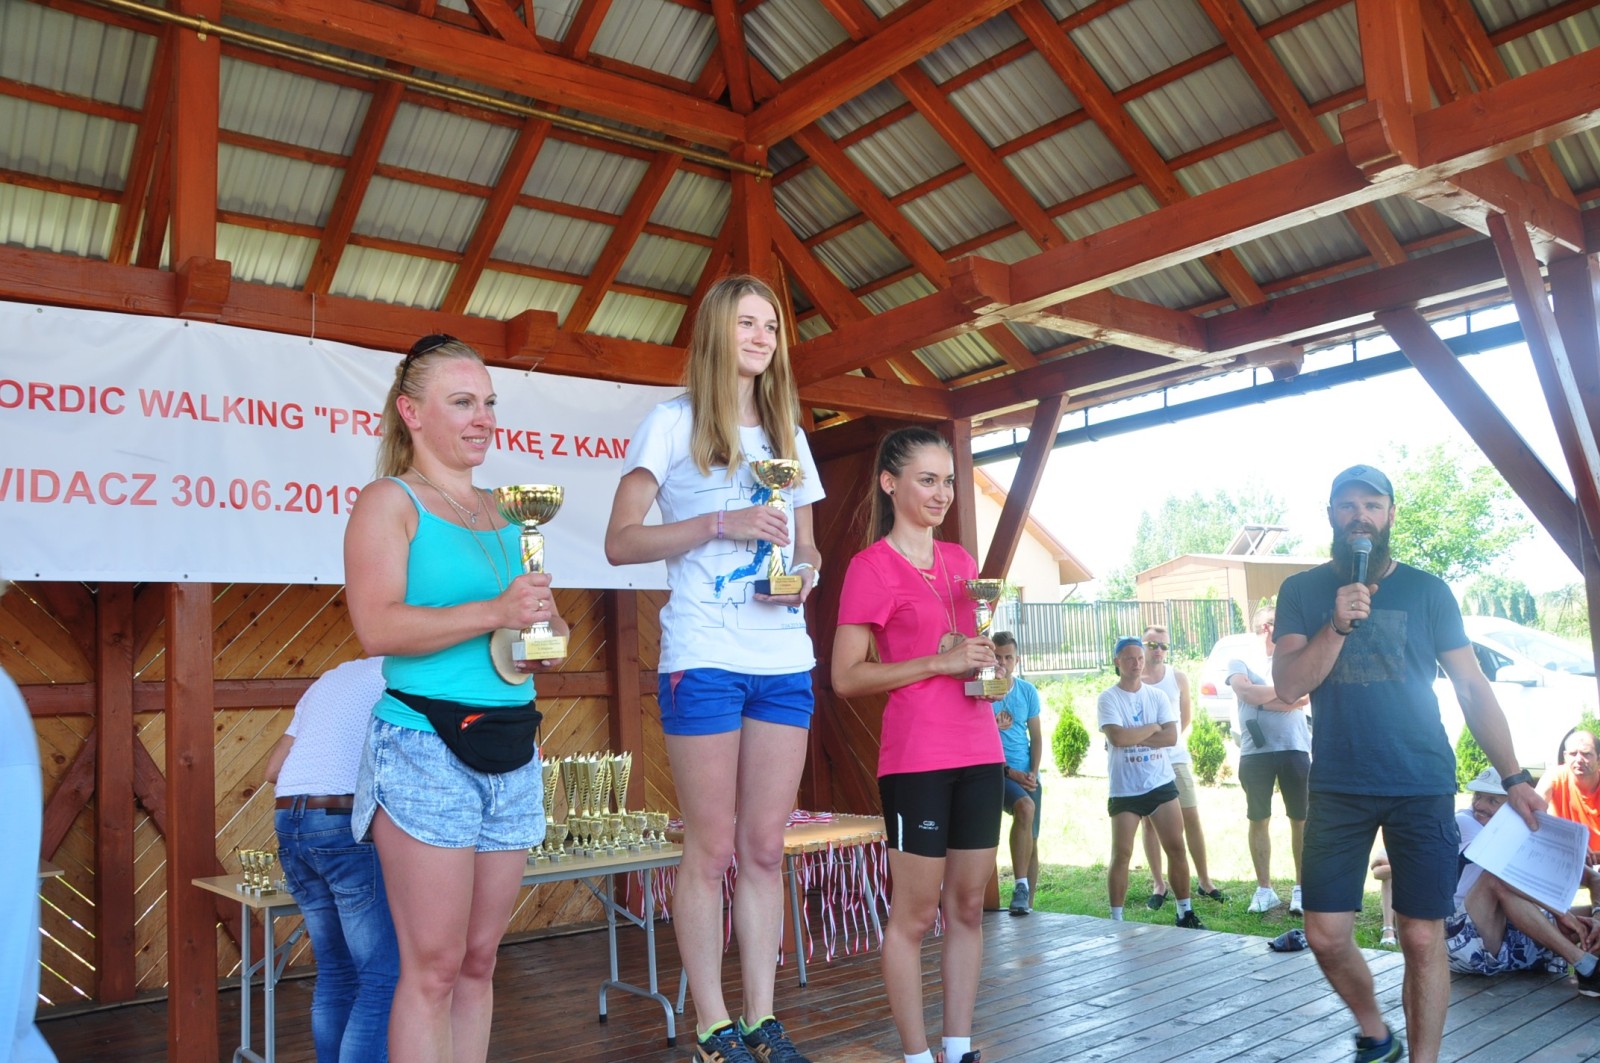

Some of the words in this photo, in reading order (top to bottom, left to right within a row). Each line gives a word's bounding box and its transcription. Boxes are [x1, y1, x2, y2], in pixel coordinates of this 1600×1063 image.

[0, 379, 126, 416] ORDIC
[138, 388, 304, 430] WALKING
[551, 434, 568, 456] Z
[171, 474, 362, 515] 30.06.2019
